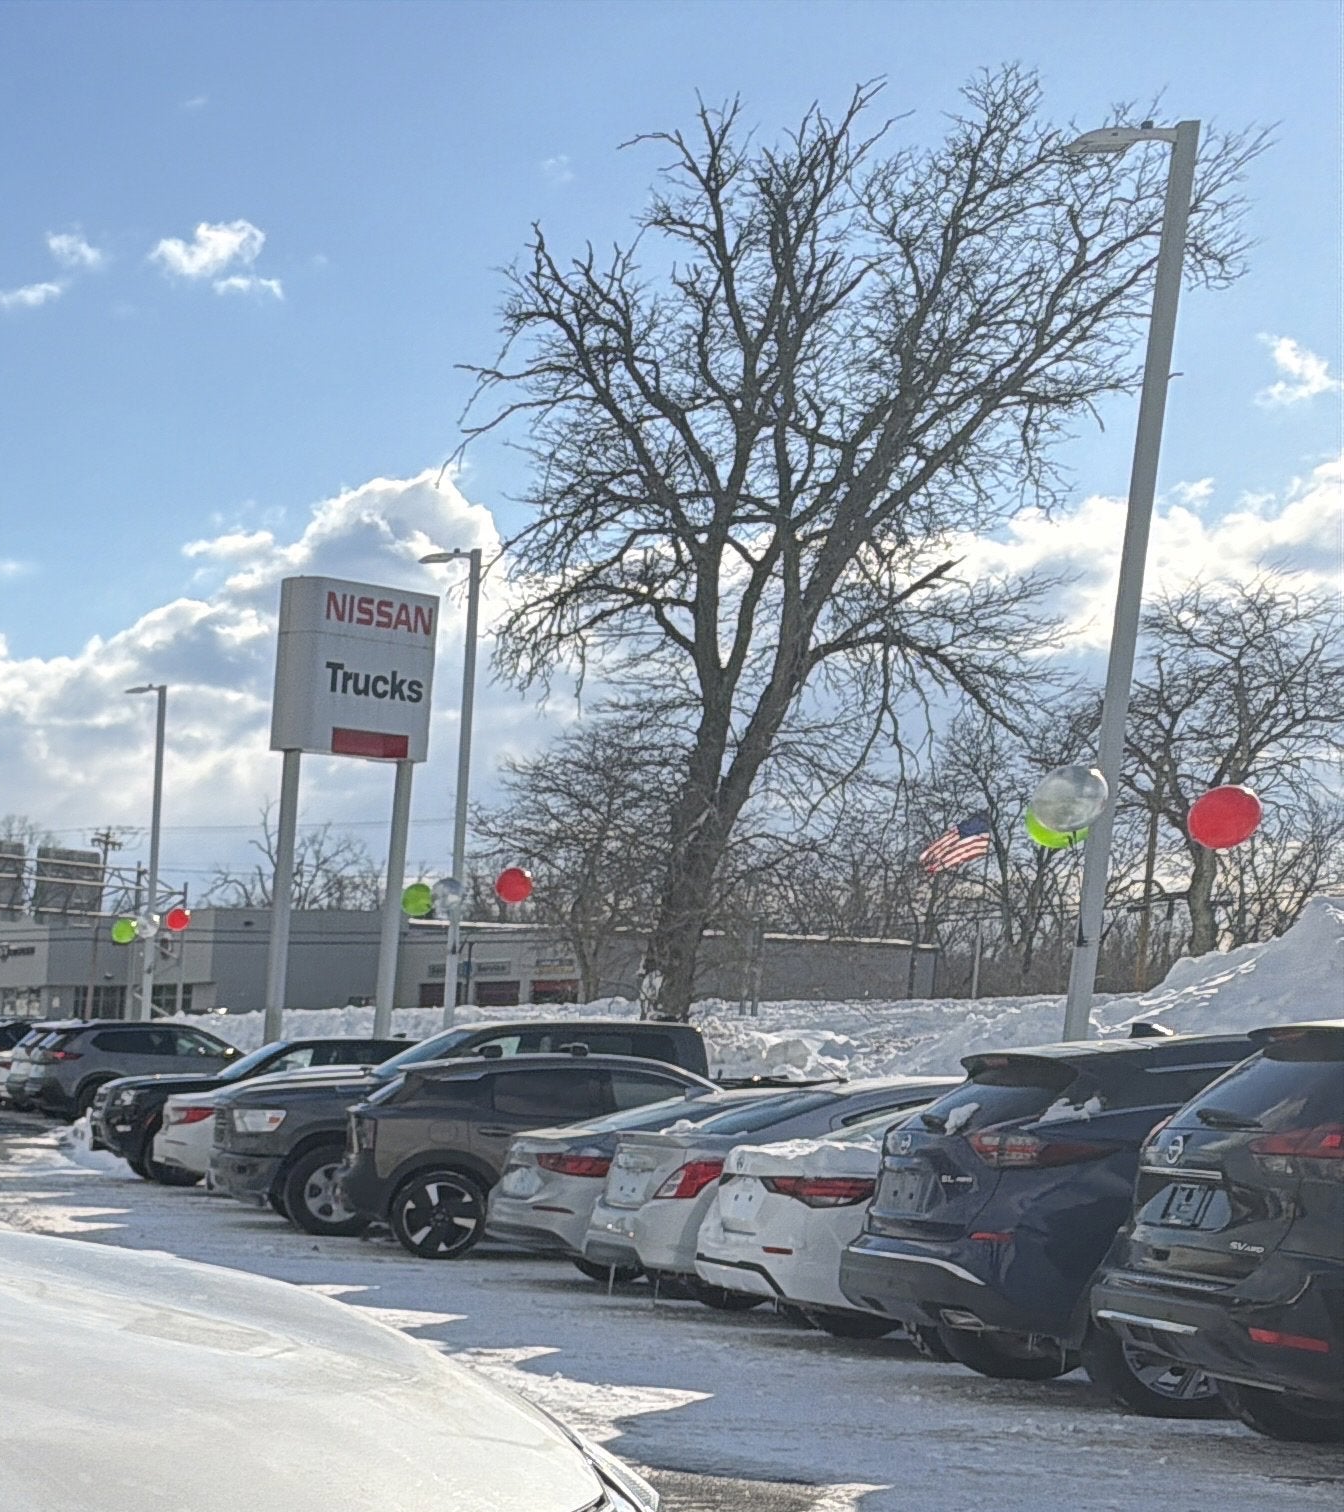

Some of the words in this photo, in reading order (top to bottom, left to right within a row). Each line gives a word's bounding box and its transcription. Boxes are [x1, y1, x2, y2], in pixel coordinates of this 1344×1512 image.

[325, 591, 434, 636] NISSAN
[325, 661, 423, 704] Trucks
[1230, 1241, 1246, 1251] SV
